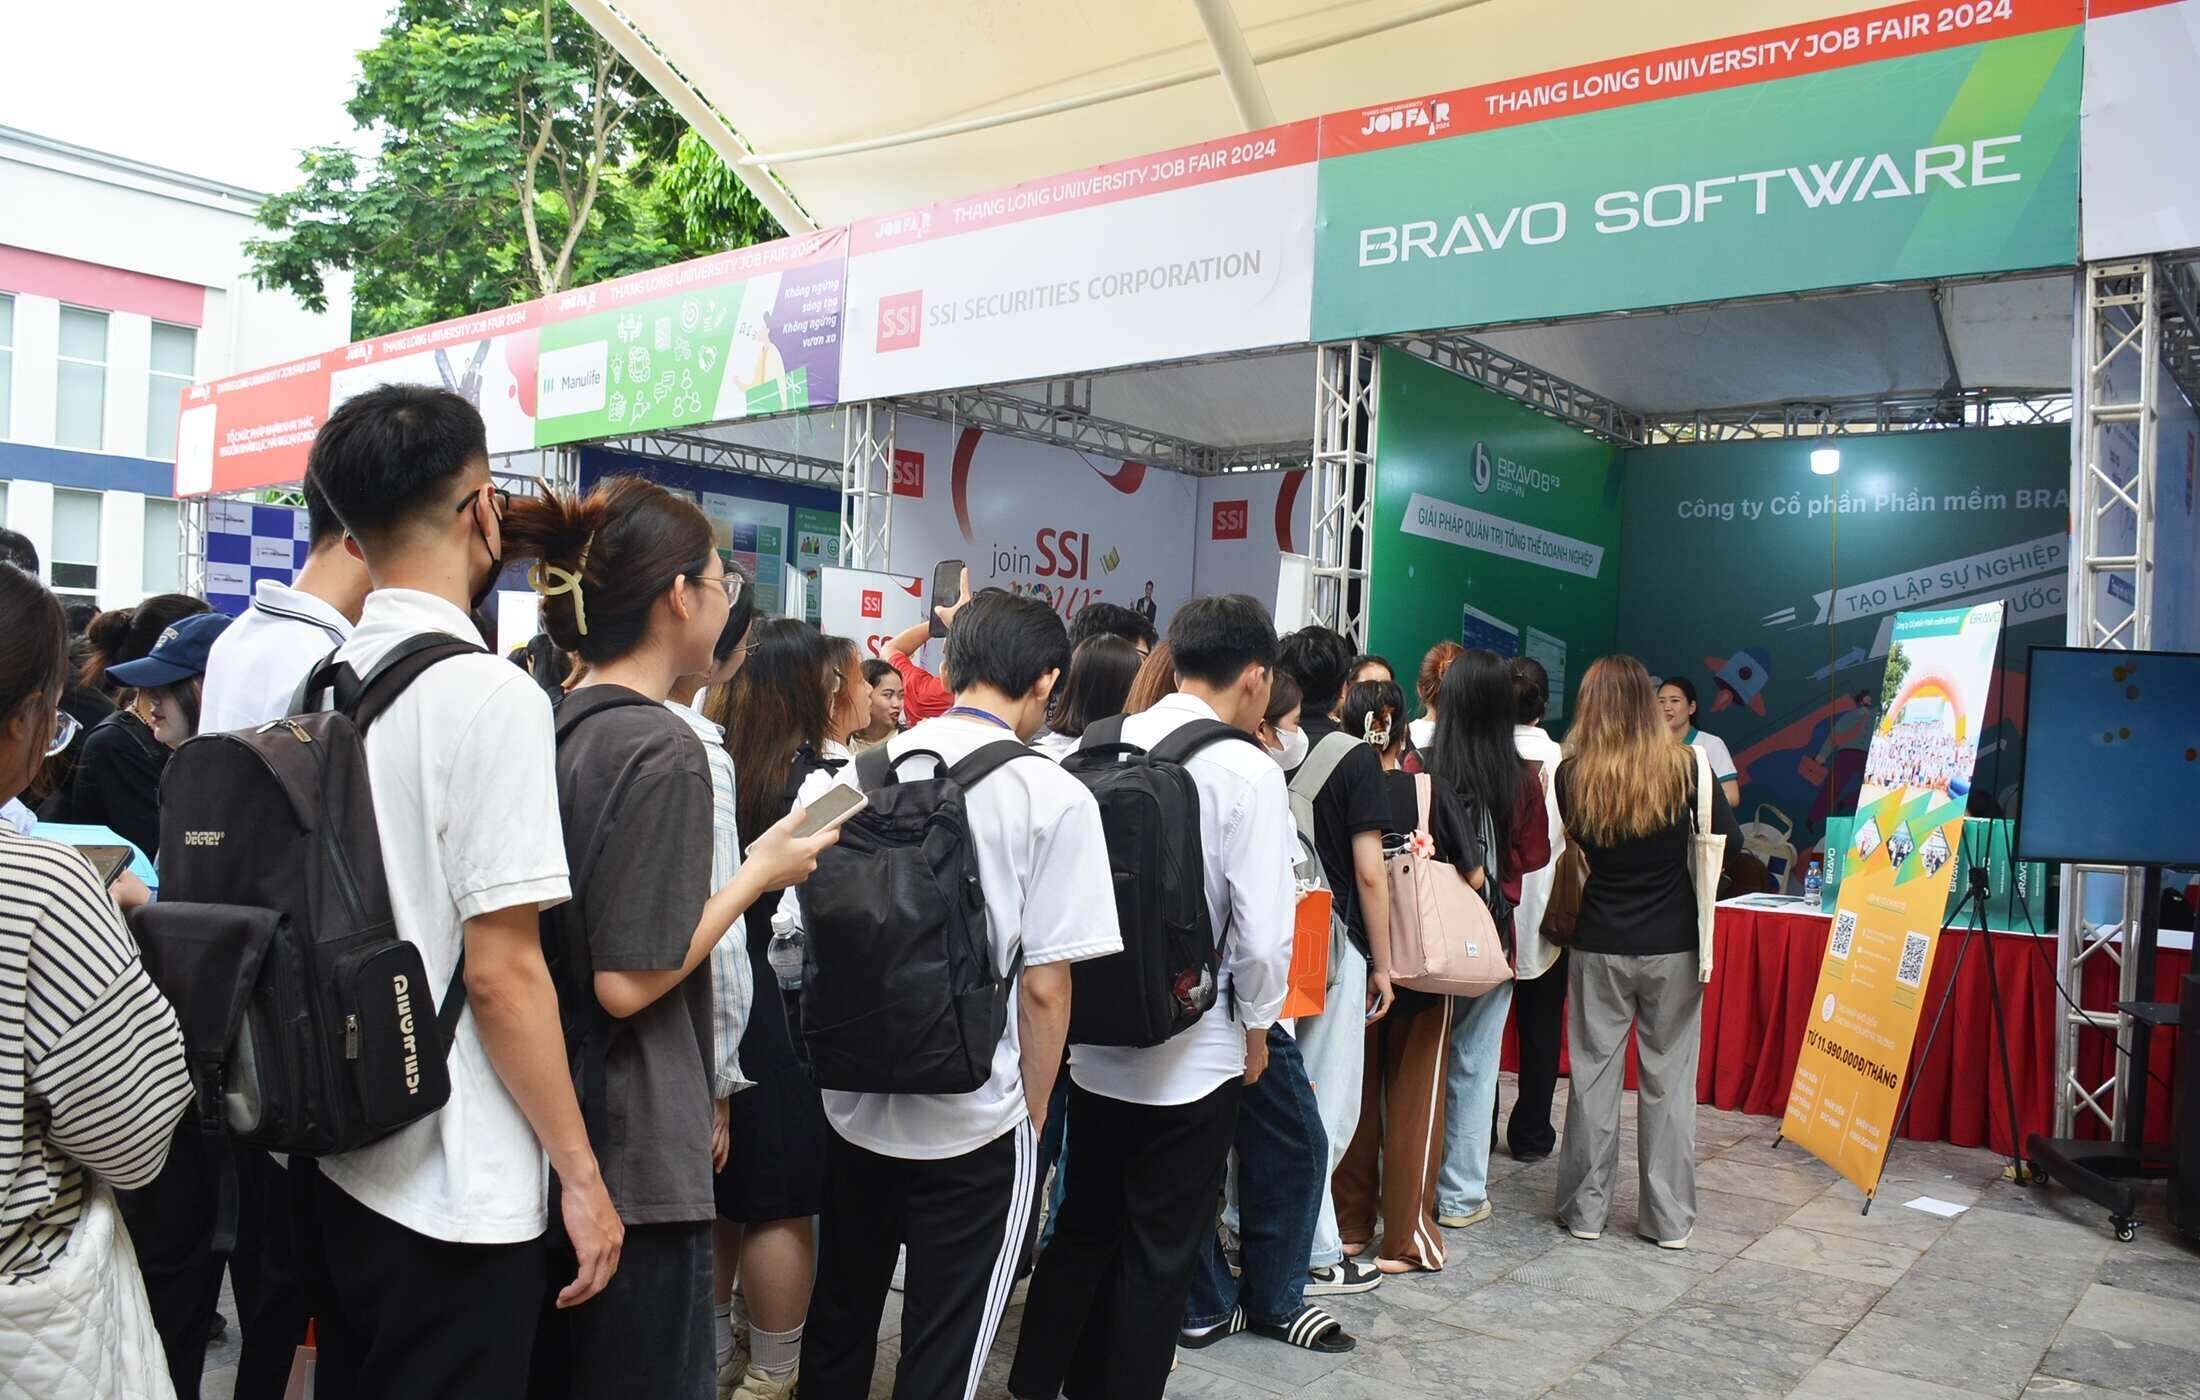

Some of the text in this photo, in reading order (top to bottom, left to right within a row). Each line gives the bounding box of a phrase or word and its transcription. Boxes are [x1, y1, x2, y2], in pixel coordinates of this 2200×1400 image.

[1485, 0, 2014, 115] THANG LONG UNIVERSITY JOB FAIR 2024
[1361, 111, 1403, 135] JOB
[952, 138, 1276, 224] THANG LONG UNIVERSITY JOB FAIR 2024
[1358, 135, 2022, 267] BRAVO SOFTWARE
[611, 281, 645, 298] THANG
[646, 275, 674, 291] LONG
[675, 261, 738, 284] UNIVERSITY
[739, 254, 761, 270] JOB
[762, 247, 790, 264] FAIR
[881, 249, 1262, 339] SSI SSI SECURITIES CORPORATION
[783, 320, 808, 335] Không
[561, 364, 600, 390] Manulife
[893, 460, 920, 486] SSI
[1216, 510, 1244, 531] SSI
[1677, 498, 1735, 521] Công
[1742, 499, 1764, 521] ty
[1770, 491, 1801, 516] Cổ
[1807, 488, 1867, 517] phần
[1875, 487, 1936, 513] Phần
[1943, 488, 2007, 511] mềm
[989, 527, 1089, 581] join SSI
[1542, 541, 1568, 560] DOANH
[1846, 545, 2061, 613] TẠO LẬP SỰ NGHIỆP
[863, 596, 880, 612] SSI
[185, 831, 221, 845] DEGREY
[1825, 847, 1836, 884] BRAVO
[1817, 1035, 1898, 1089] 11.990.000Đ/THÁNG
